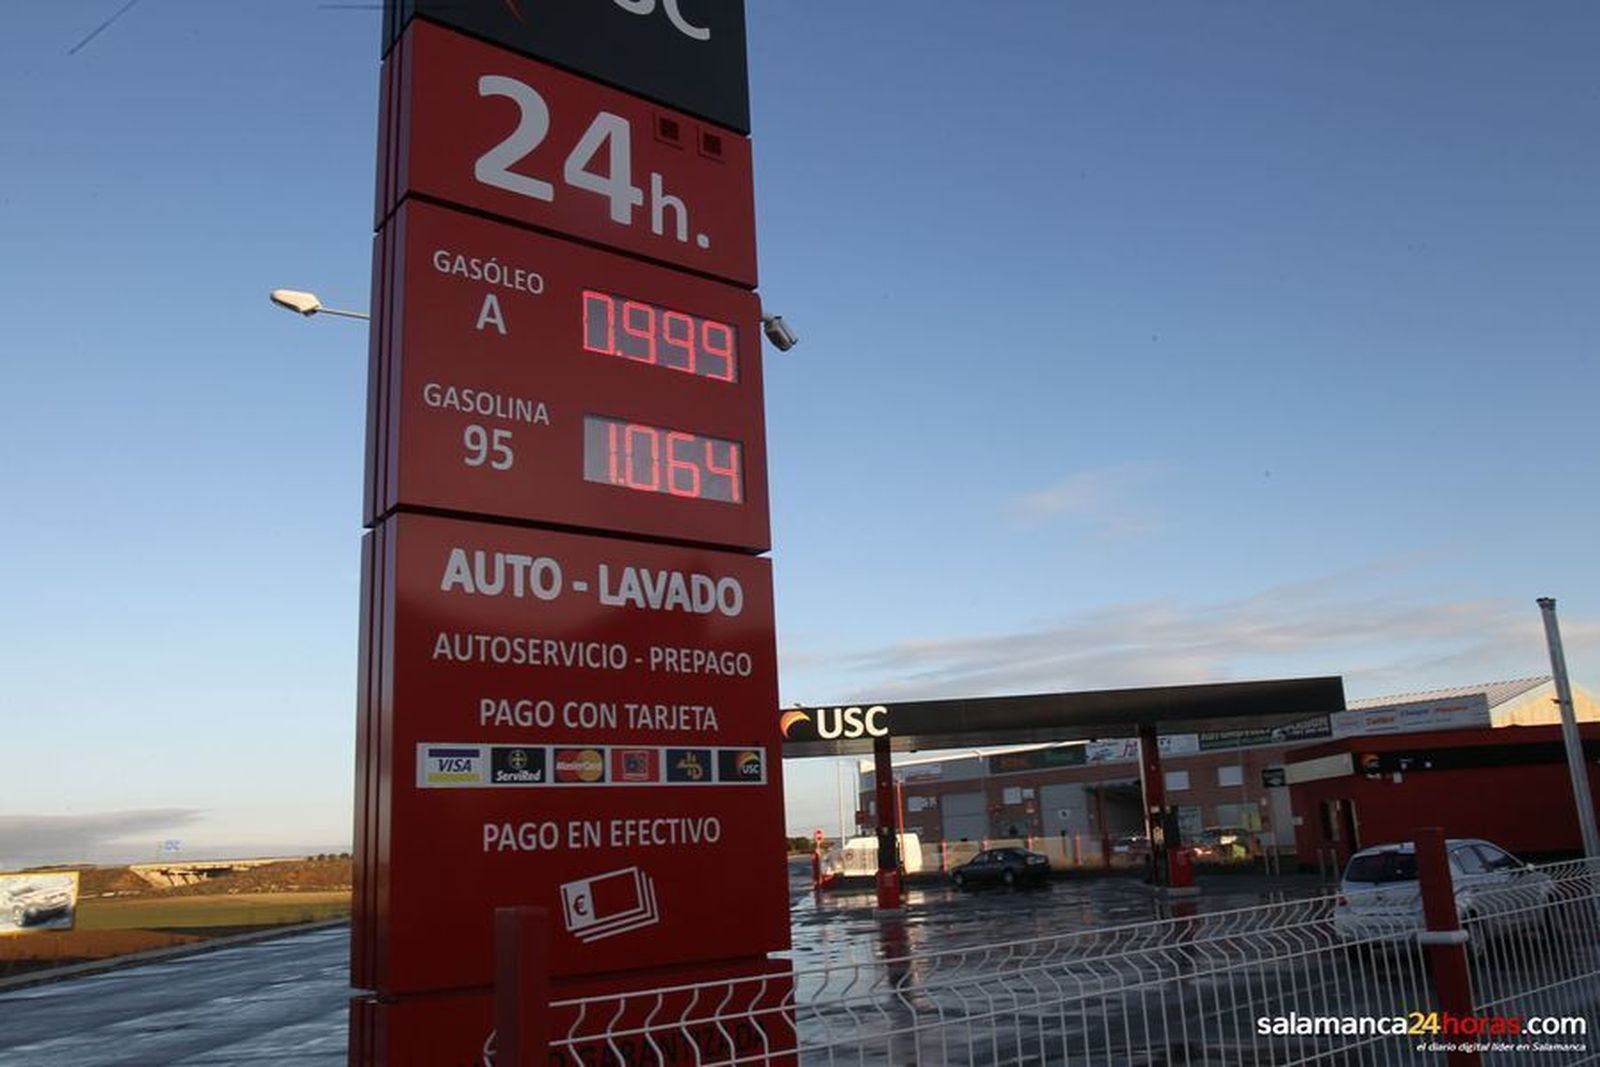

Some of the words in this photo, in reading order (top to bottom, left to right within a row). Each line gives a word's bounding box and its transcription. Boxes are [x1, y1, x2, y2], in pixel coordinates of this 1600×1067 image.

[433, 250, 544, 294] GASÓLEO
[476, 294, 507, 335] A
[423, 382, 550, 426] GASOLINA
[463, 425, 514, 470] 95
[608, 422, 740, 501] 1.064
[441, 548, 562, 600] AUTO
[599, 564, 743, 617] LAVADO
[433, 633, 627, 670] AUTOSERVICIO
[650, 647, 752, 677] PREPAGO
[480, 699, 554, 728] PAGO
[563, 702, 617, 730] CON
[625, 704, 719, 731] TARJETA
[816, 705, 889, 739] USC
[438, 758, 472, 773] VISA
[496, 769, 541, 782] ServiRed
[742, 763, 760, 775] USC
[483, 821, 559, 852] PAGO
[568, 821, 600, 849] EN
[610, 816, 721, 847] EFECTIVO
